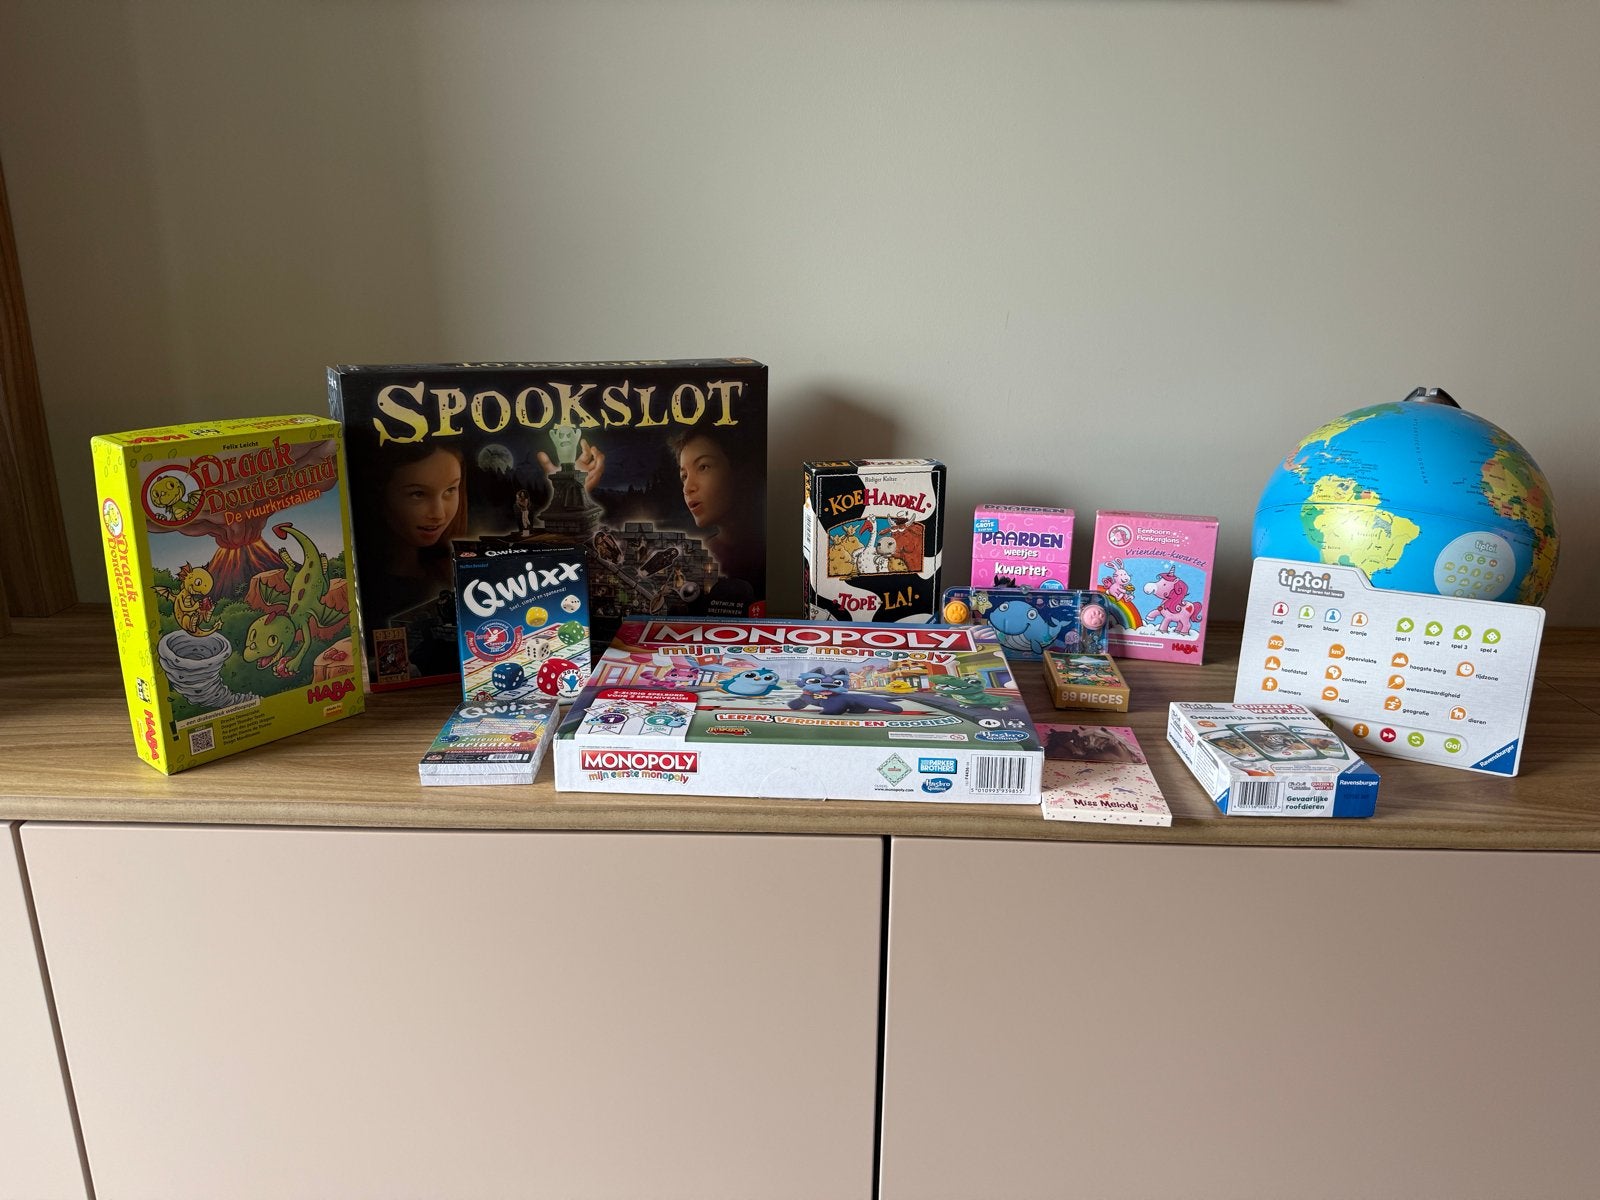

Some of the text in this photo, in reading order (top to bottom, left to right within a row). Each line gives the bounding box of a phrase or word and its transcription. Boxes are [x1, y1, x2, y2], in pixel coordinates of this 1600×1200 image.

[374, 380, 742, 447] SPOOKSLOT
[223, 441, 258, 450] Felix Leicht
[196, 436, 296, 488] Draak
[203, 456, 336, 514] Donderland
[225, 488, 321, 525] De vuurkristallen
[984, 504, 1065, 513] PAARDEN
[982, 530, 1063, 548] PAARDEN
[1136, 535, 1180, 544] Flonkerglans
[485, 549, 528, 557] Qwixx
[1475, 540, 1497, 553] tiptoi
[1004, 549, 1038, 559] weetjes
[121, 535, 139, 603] Draak
[995, 562, 1048, 576] kwartet
[107, 537, 133, 628] Donderland
[1278, 568, 1331, 591] tiptoi
[463, 562, 582, 617] Qwixx
[653, 625, 962, 649] MONOPOLY
[663, 645, 721, 656] mijn
[727, 645, 807, 654] eerste
[816, 646, 952, 663] monopoly
[1172, 643, 1198, 654] HABA
[1345, 656, 1377, 664] oppervlakte
[1410, 664, 1447, 675] hoogste berg
[1342, 677, 1367, 685] continent
[308, 679, 355, 704] HABA
[1062, 691, 1124, 705] 99 PIECES
[459, 703, 551, 719] Qwixx
[1402, 708, 1430, 716] geografie
[719, 713, 773, 722] LEREN,
[775, 716, 860, 727] VERDIENEN
[888, 716, 961, 727] GROEIEN!
[144, 709, 159, 761] HABA
[980, 730, 1024, 738] Hasbro
[1445, 742, 1461, 750] Go!
[585, 752, 696, 770] MONOPOLY
[1480, 744, 1515, 768] Ravensburger
[589, 770, 689, 784] mijn eerste monopoly
[925, 779, 950, 788] Hasbro
[1074, 799, 1138, 810] Miss Melody
